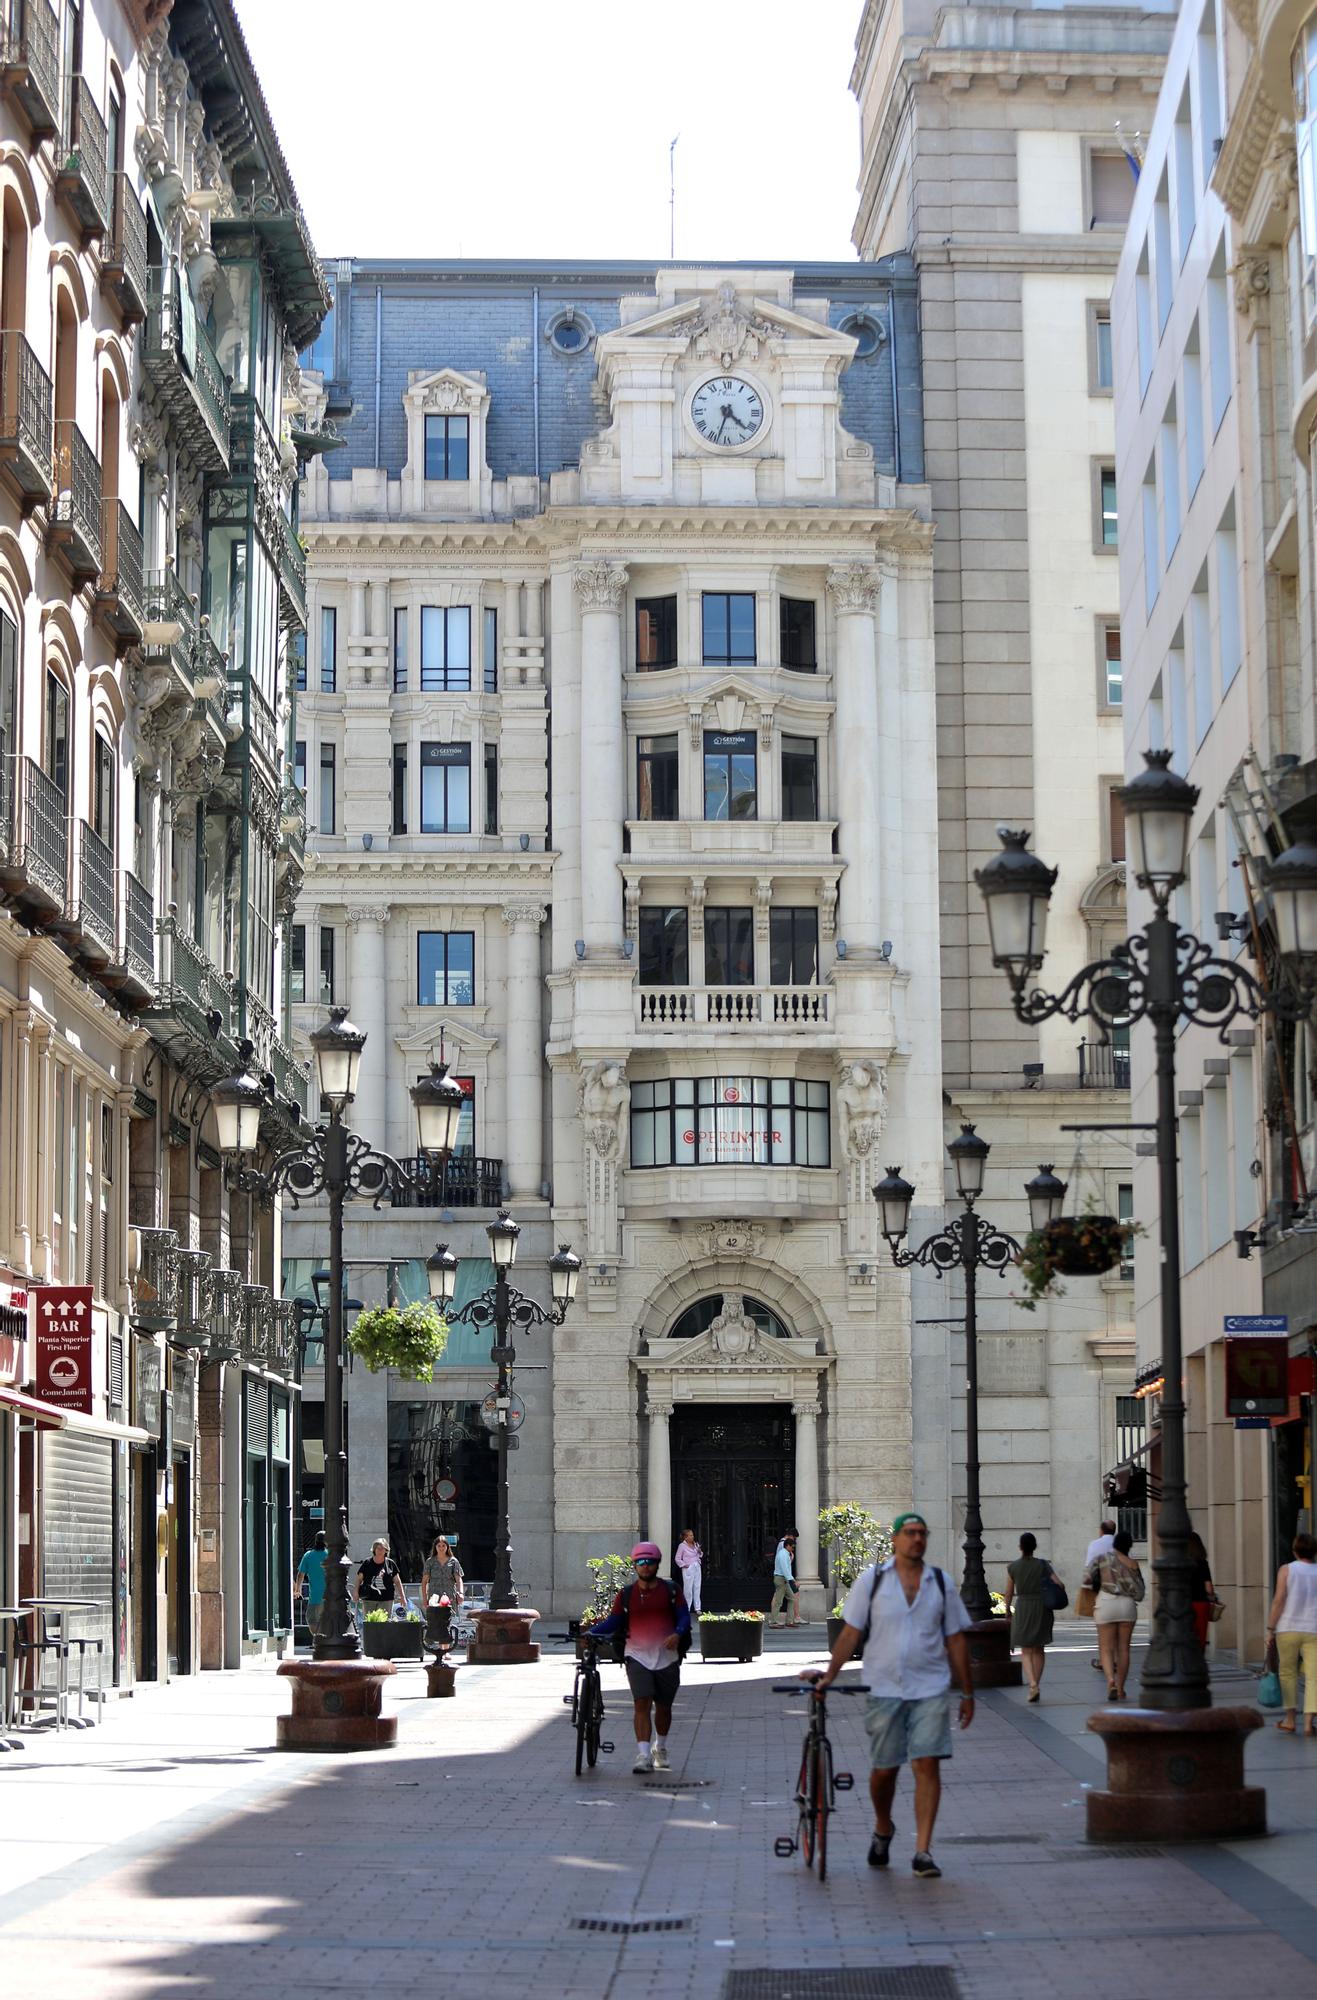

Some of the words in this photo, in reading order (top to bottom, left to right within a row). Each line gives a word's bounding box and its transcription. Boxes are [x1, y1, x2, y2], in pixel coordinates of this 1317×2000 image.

[726, 1238, 738, 1247] 42
[49, 1320, 80, 1332] BAR
[61, 1335, 90, 1345] Superior
